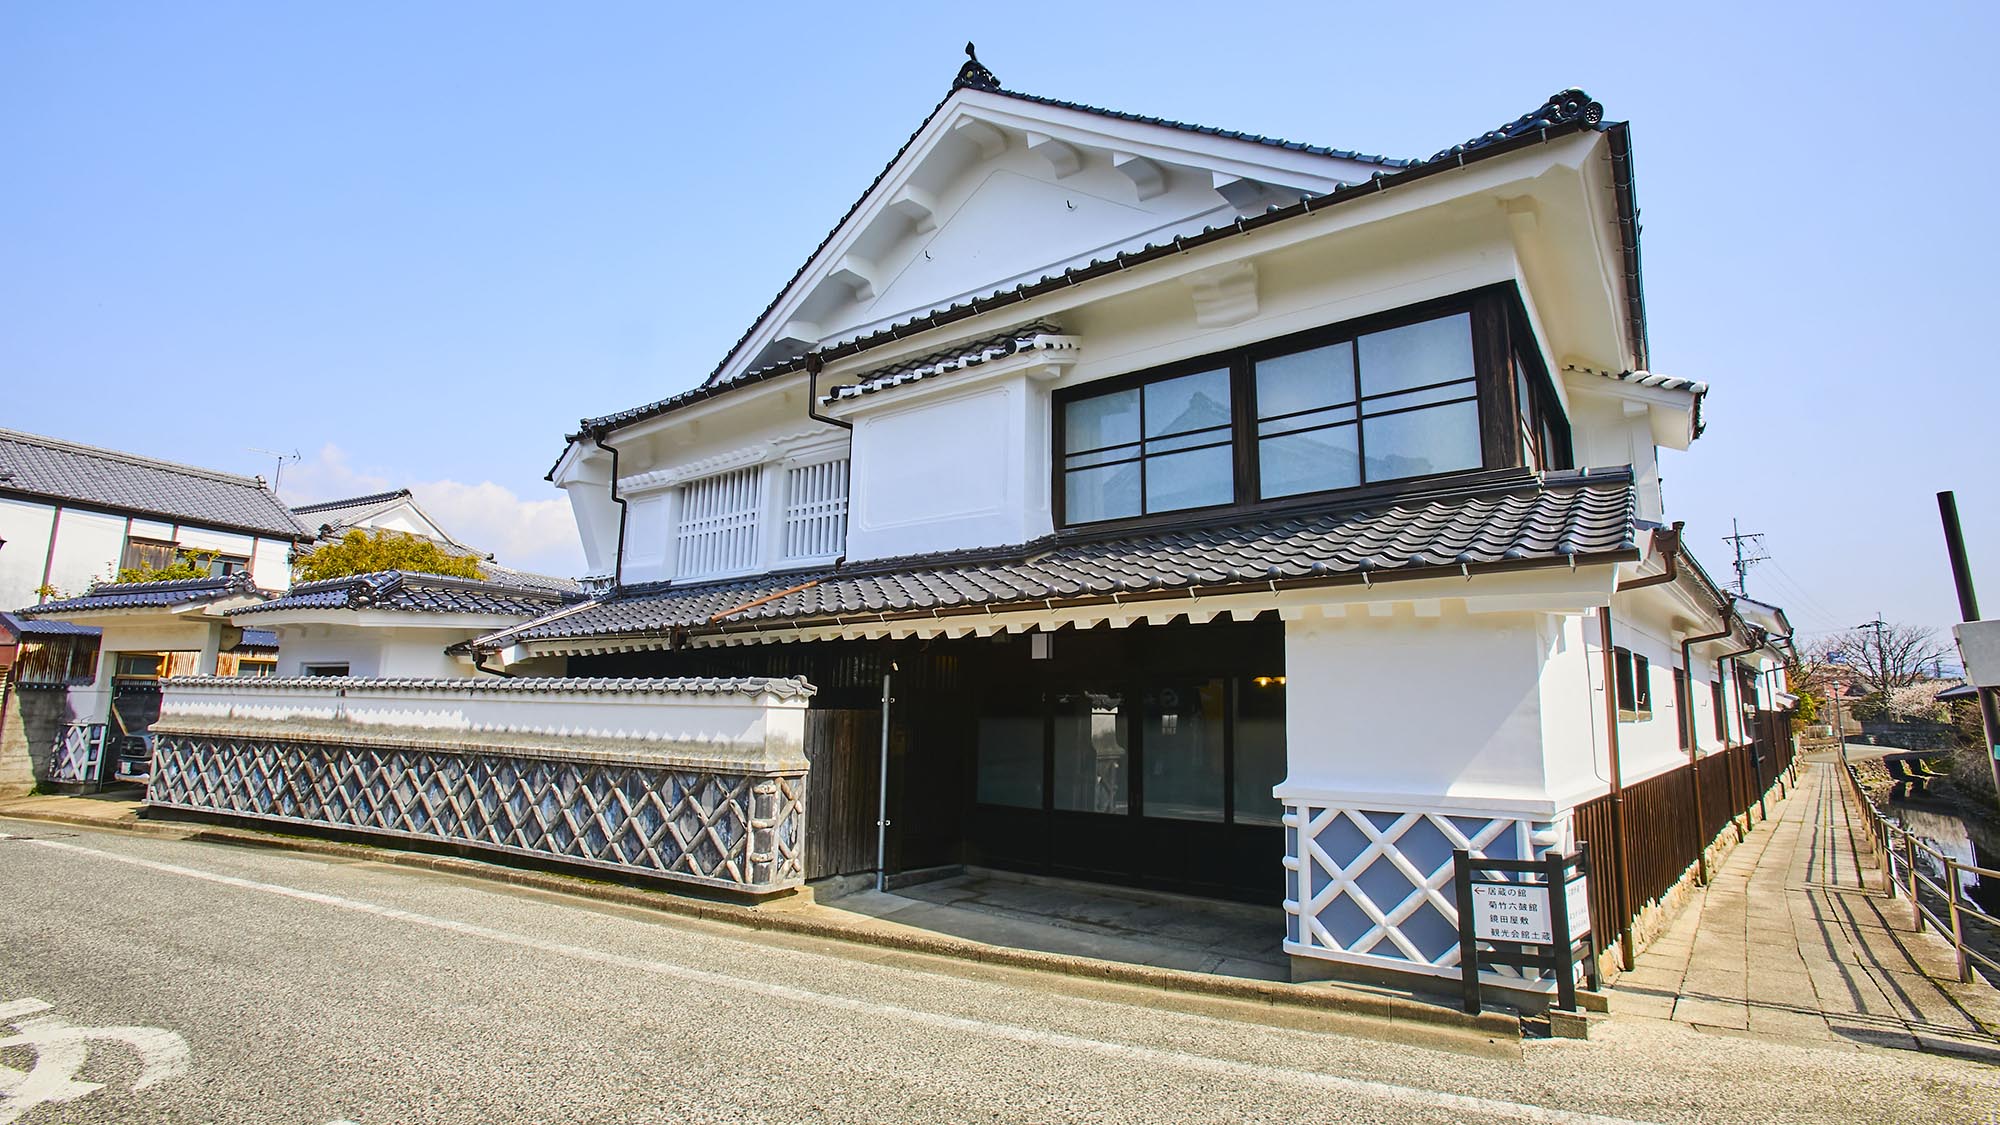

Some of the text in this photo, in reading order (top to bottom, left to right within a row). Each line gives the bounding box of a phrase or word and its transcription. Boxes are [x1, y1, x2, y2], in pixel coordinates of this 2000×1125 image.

[1487, 887, 1527, 897] 居蔵の館
[1490, 914, 1529, 924] 鏡田屋敷
[1490, 928, 1551, 941] 観光会館土蔵
